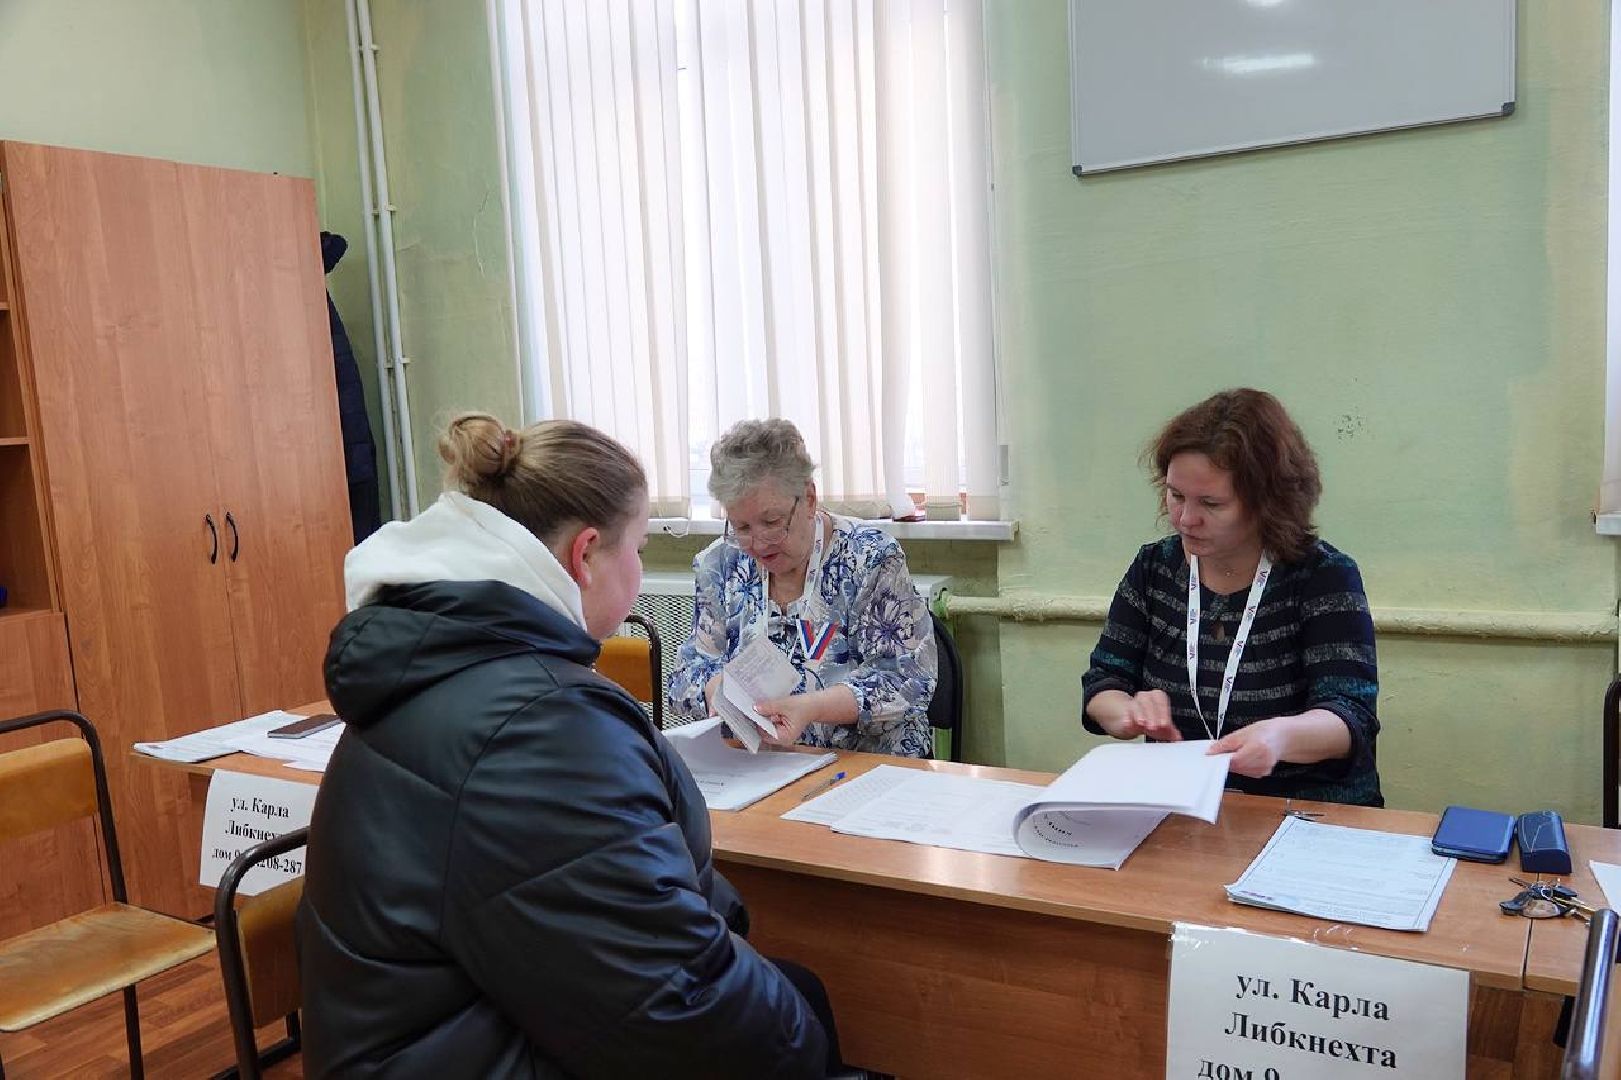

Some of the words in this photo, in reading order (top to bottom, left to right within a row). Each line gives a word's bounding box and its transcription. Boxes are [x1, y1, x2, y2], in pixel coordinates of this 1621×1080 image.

[229, 797, 249, 812] ул.
[252, 797, 289, 819] Карла
[1235, 974, 1279, 999] ул.
[1290, 977, 1390, 1021] Карла
[1224, 1011, 1397, 1069] Либкнехта
[1197, 1059, 1253, 1080] дом
